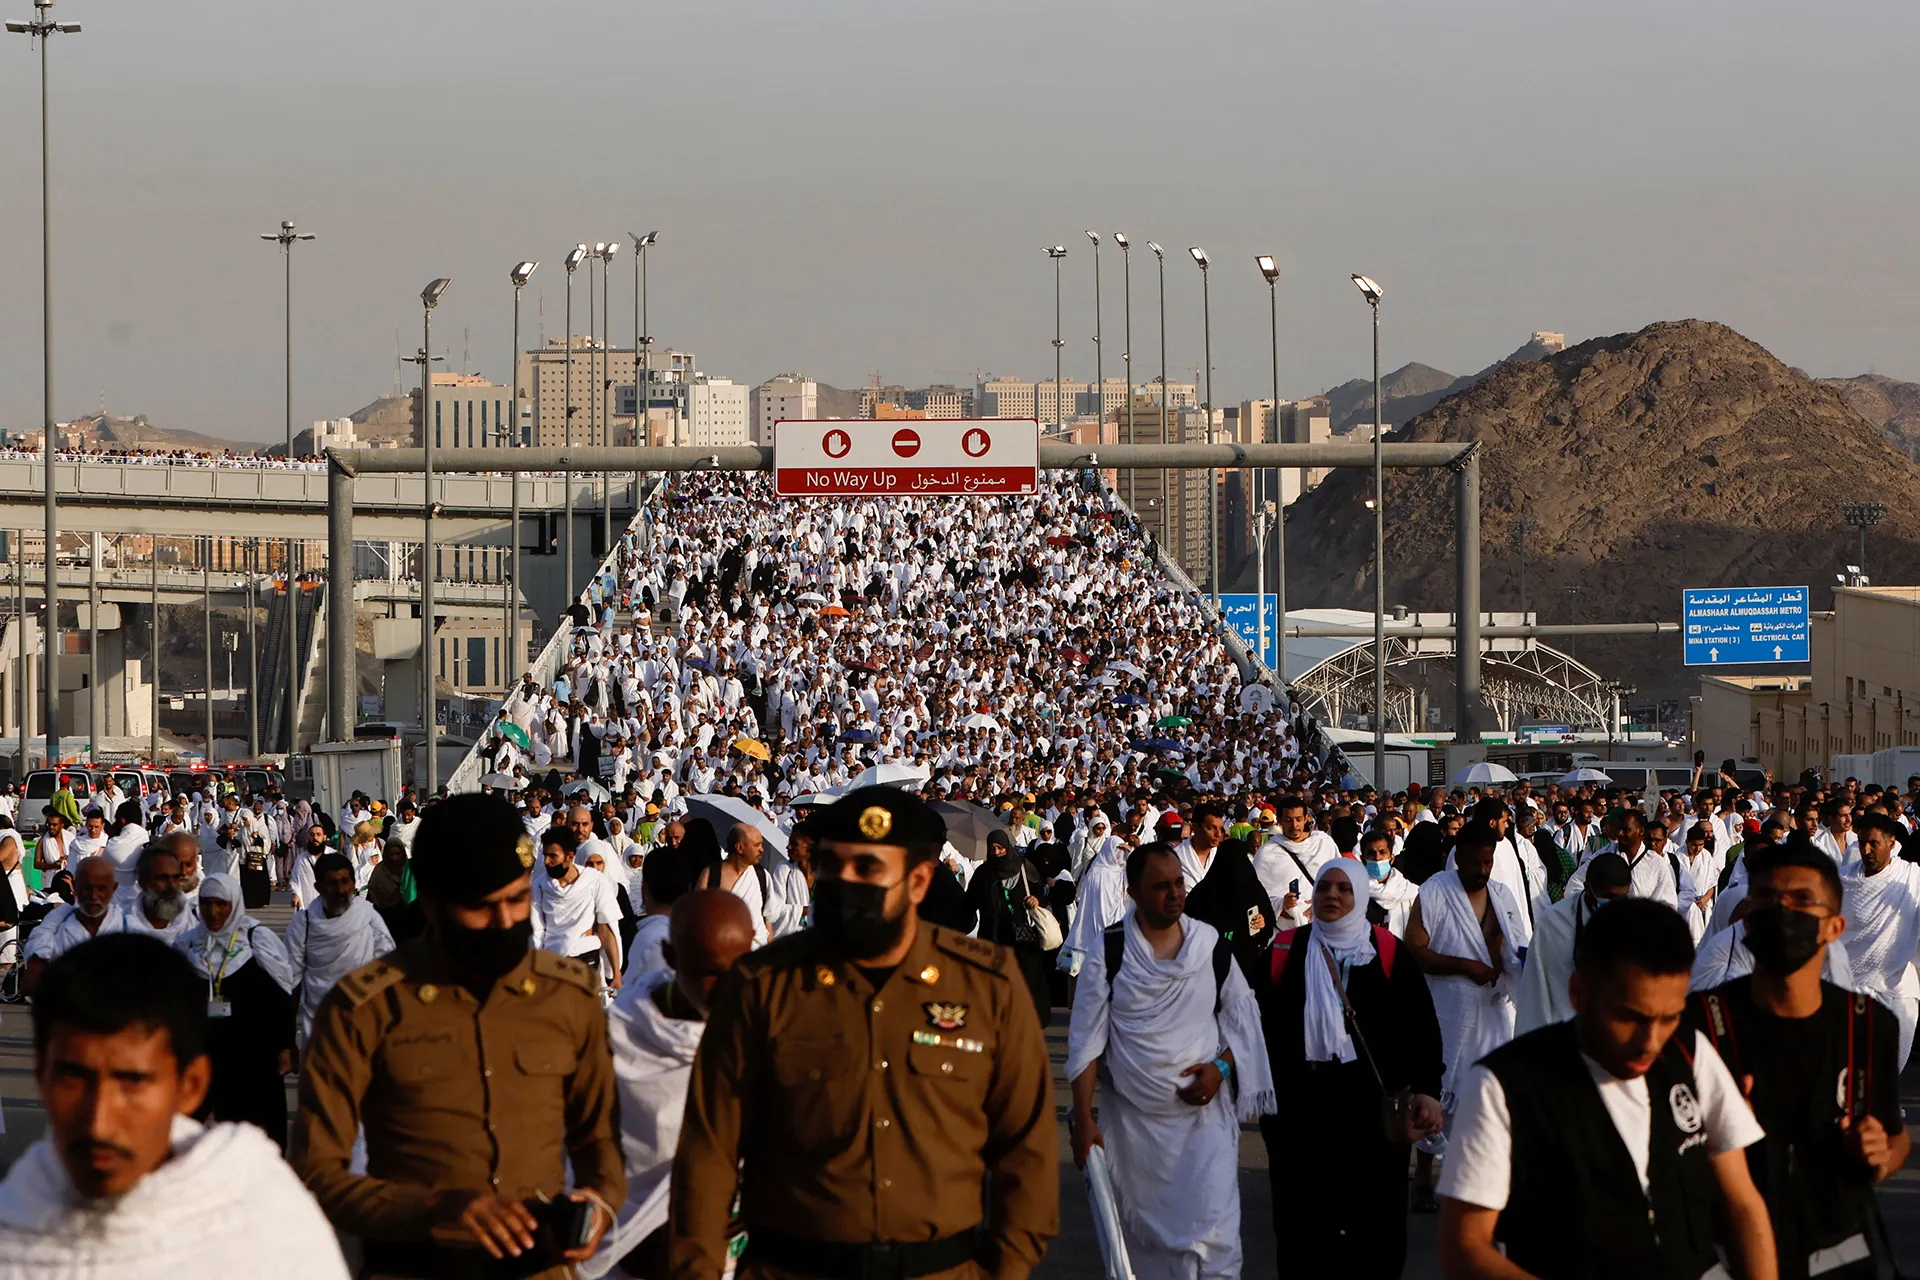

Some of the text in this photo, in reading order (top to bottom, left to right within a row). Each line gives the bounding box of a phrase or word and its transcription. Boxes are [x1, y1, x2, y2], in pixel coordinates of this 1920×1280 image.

[806, 472, 897, 490] No Way Up
[911, 471, 1006, 492] ممنوع الدخول
[1689, 590, 1803, 606] قطار المشاعر المقدسة
[1226, 602, 1256, 617] الحرم
[1689, 606, 1803, 617] ALMASHAAR ALMUQDASSAH METRO
[1688, 637, 1703, 645] MINA
[1704, 637, 1728, 645] STATION
[1751, 633, 1805, 642] ELECTRICAL CAR
